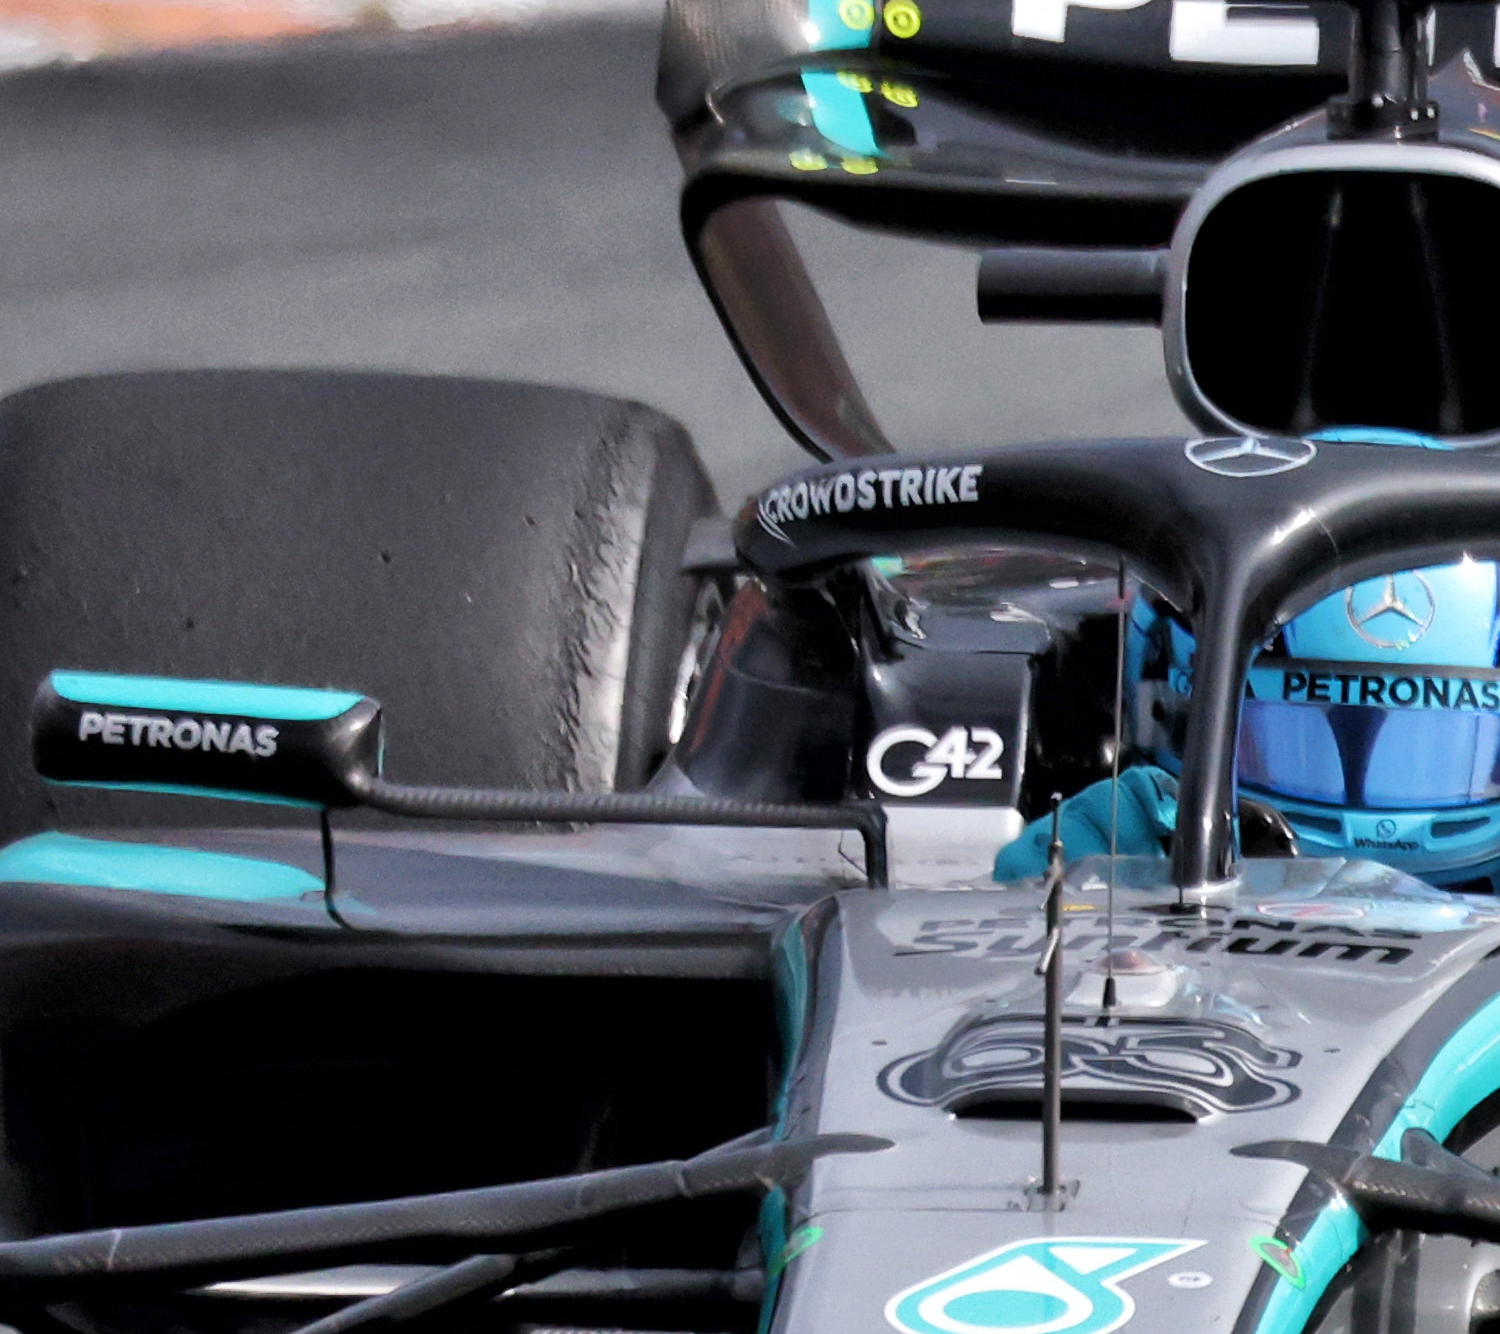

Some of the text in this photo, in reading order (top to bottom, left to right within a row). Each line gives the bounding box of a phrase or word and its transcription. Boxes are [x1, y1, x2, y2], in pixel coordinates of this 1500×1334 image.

[764, 464, 983, 524] CROWDSTRIKE
[1283, 673, 1500, 710] PETRONAS
[79, 710, 280, 757] PETRONAS
[866, 724, 1003, 798] G42
